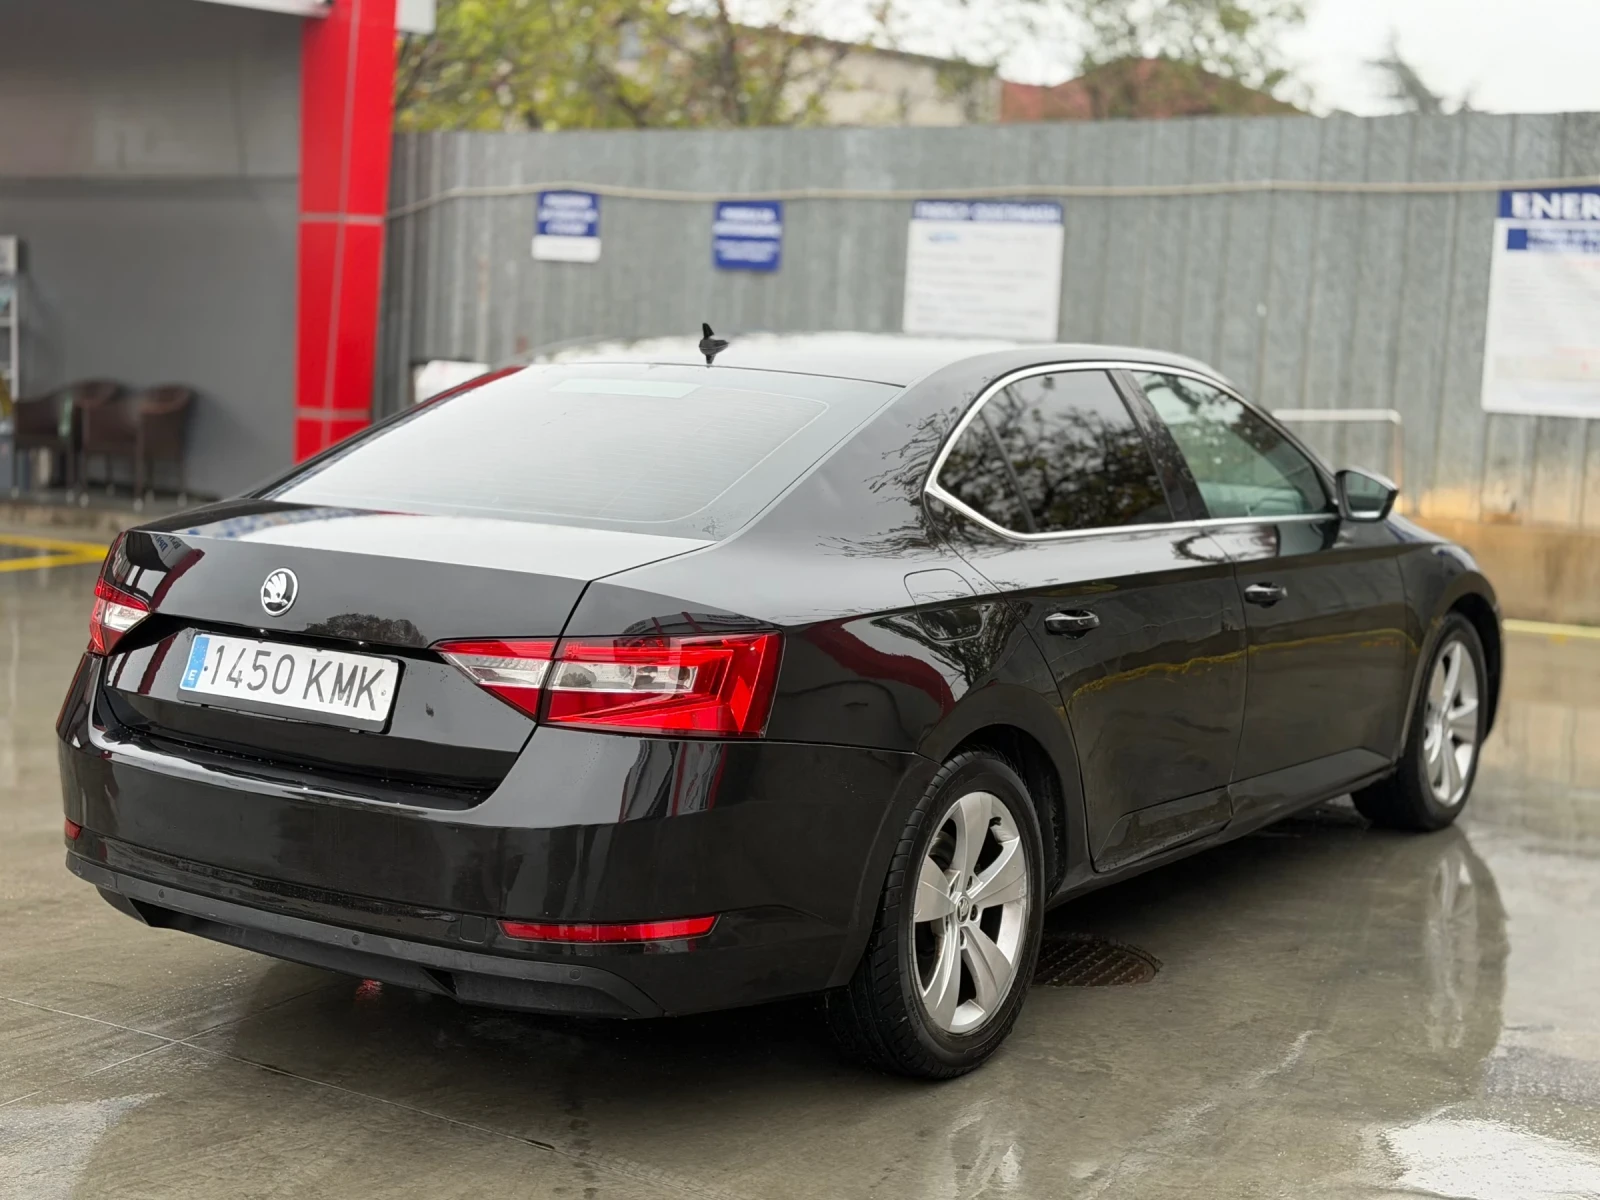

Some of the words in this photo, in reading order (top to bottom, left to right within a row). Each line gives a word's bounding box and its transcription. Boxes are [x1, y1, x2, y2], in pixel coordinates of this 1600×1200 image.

[188, 669, 195, 681] E
[210, 645, 296, 695] 1450
[302, 658, 385, 711] KMK
